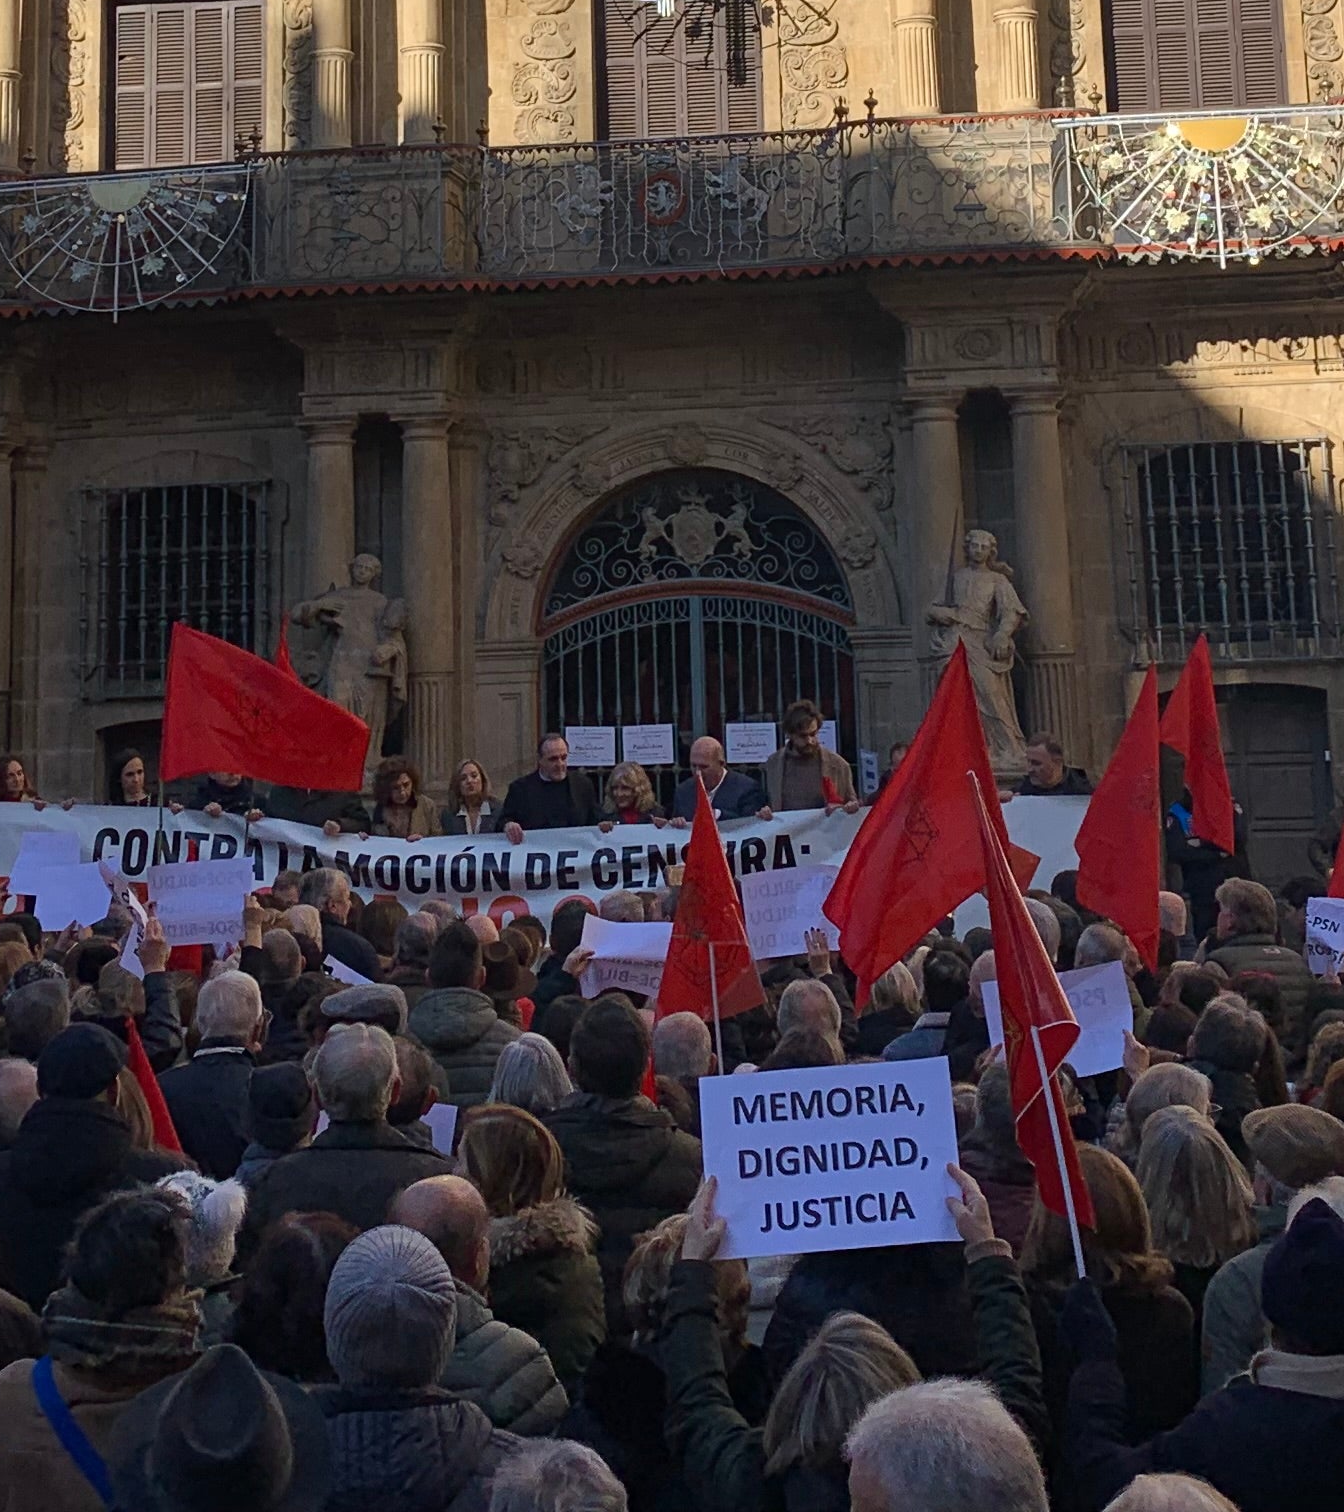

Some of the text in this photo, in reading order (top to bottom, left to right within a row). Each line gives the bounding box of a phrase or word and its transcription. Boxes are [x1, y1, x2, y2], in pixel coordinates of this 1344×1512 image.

[92, 827, 265, 881] CONTRA
[334, 846, 523, 894] MOCIÓN
[525, 850, 580, 892] DE
[733, 1083, 926, 1125] MEMORIA,
[738, 1137, 929, 1180] DIGNIDAD,
[760, 1191, 916, 1234] JUSTICIA
